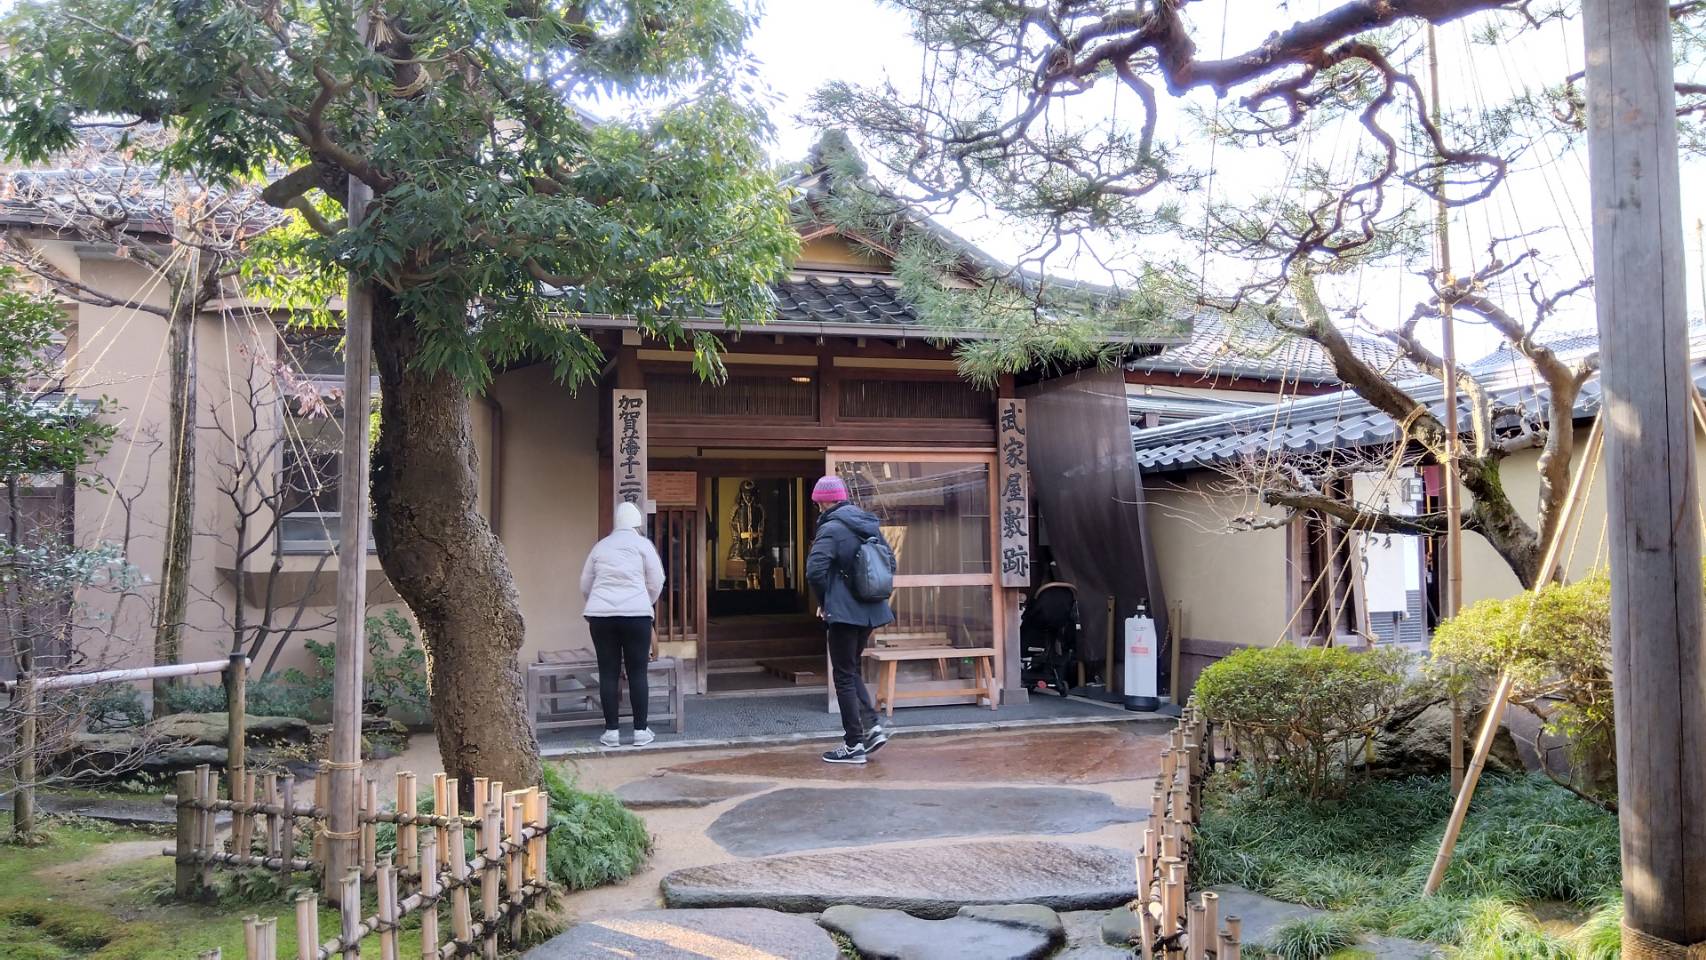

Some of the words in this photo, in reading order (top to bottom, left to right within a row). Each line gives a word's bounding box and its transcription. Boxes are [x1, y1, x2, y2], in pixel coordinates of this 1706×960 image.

[1001, 402, 1029, 577] 武家屋敷跡
